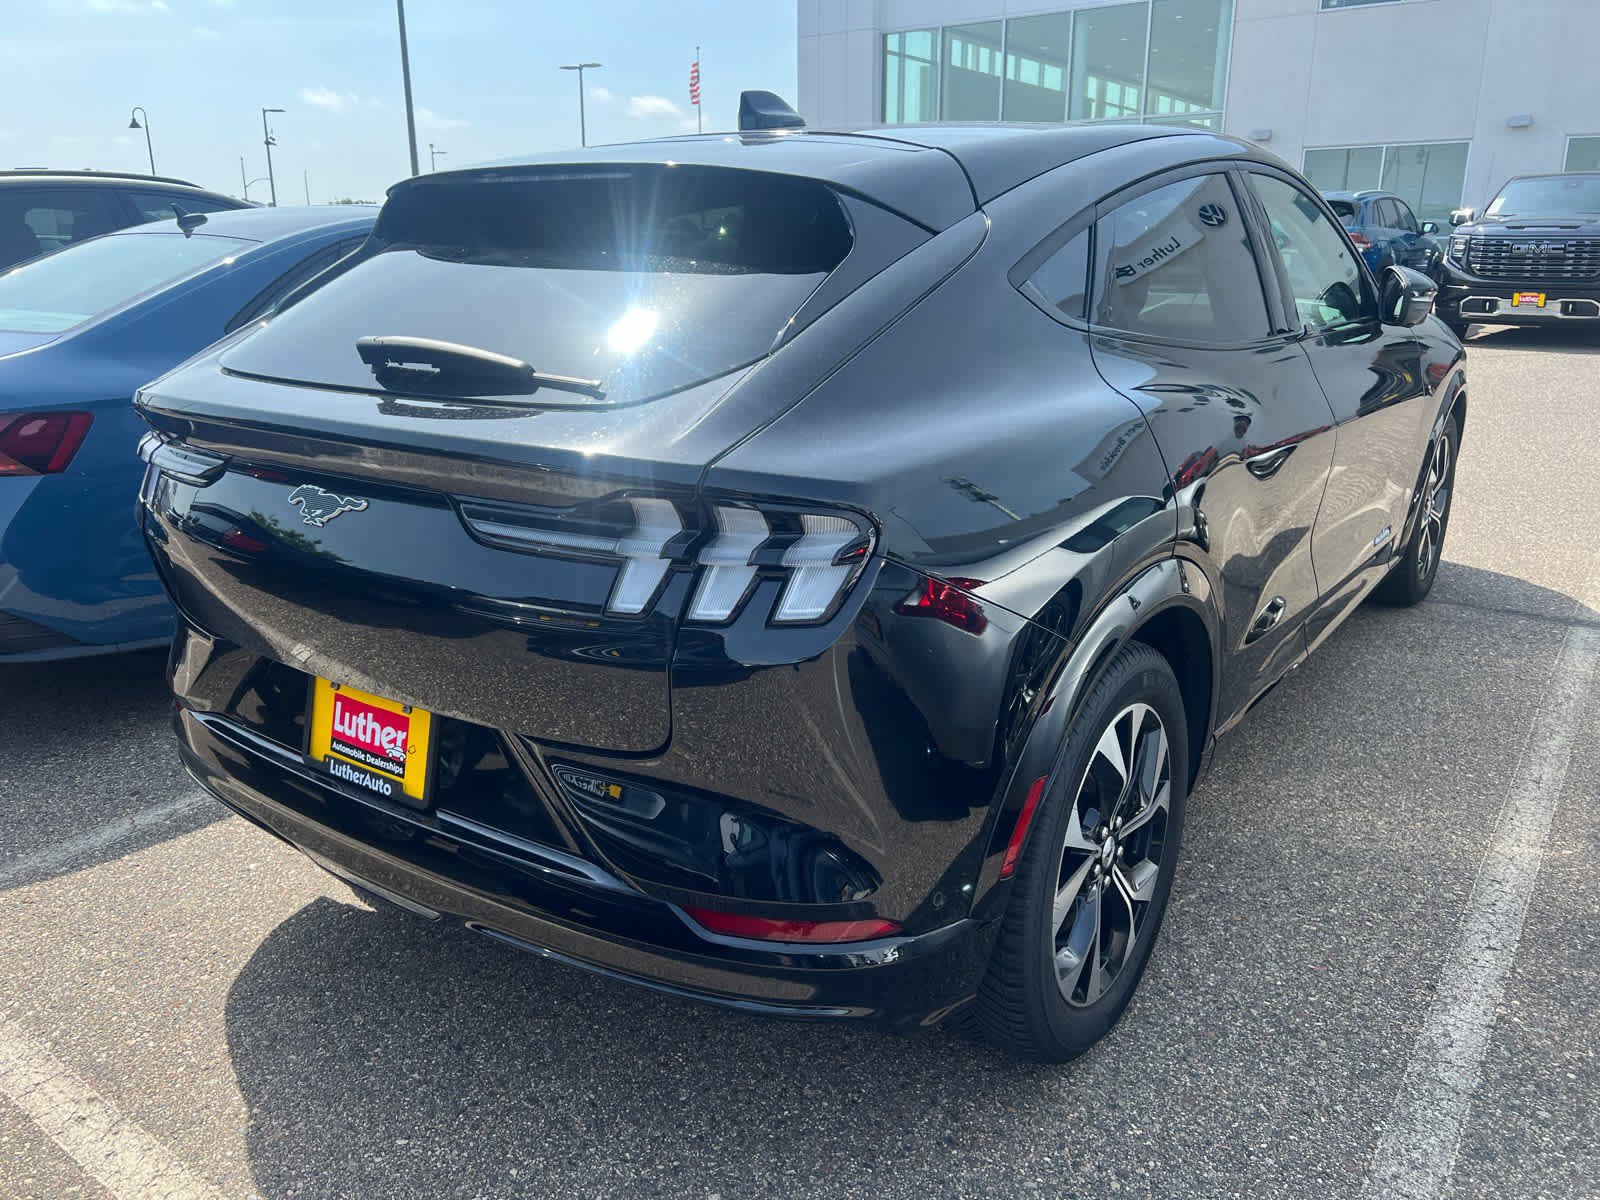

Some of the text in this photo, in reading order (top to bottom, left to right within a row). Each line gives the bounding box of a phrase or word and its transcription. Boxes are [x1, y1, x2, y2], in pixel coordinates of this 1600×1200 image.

[1511, 244, 1565, 254] GMC
[334, 701, 407, 749] Luther
[332, 740, 404, 775] Automobile Dealerships
[329, 759, 392, 796] LutherAuto
